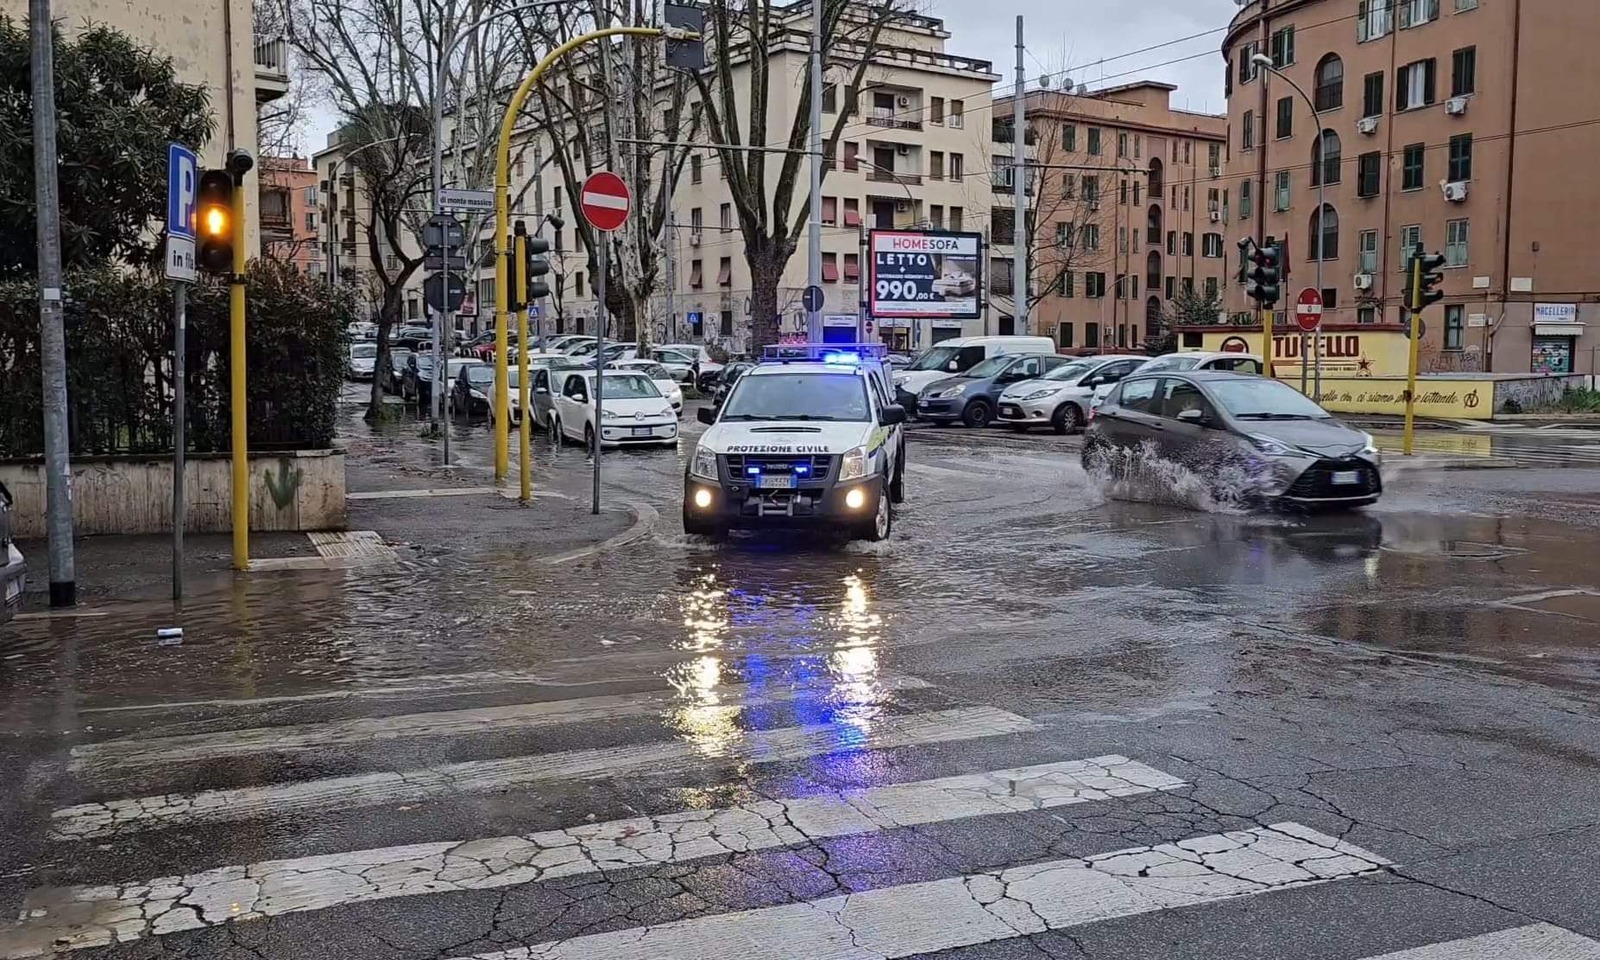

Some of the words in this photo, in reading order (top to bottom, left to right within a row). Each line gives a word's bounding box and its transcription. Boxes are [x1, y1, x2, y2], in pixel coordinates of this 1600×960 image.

[178, 155, 194, 228] P
[447, 197, 466, 205] monte
[467, 199, 493, 207] massico
[173, 250, 183, 267] in
[877, 253, 927, 266] LETTO
[1535, 305, 1576, 316] MACELLERIA
[1273, 335, 1360, 358] TUFELLO
[727, 445, 792, 453] PROTEZIONE
